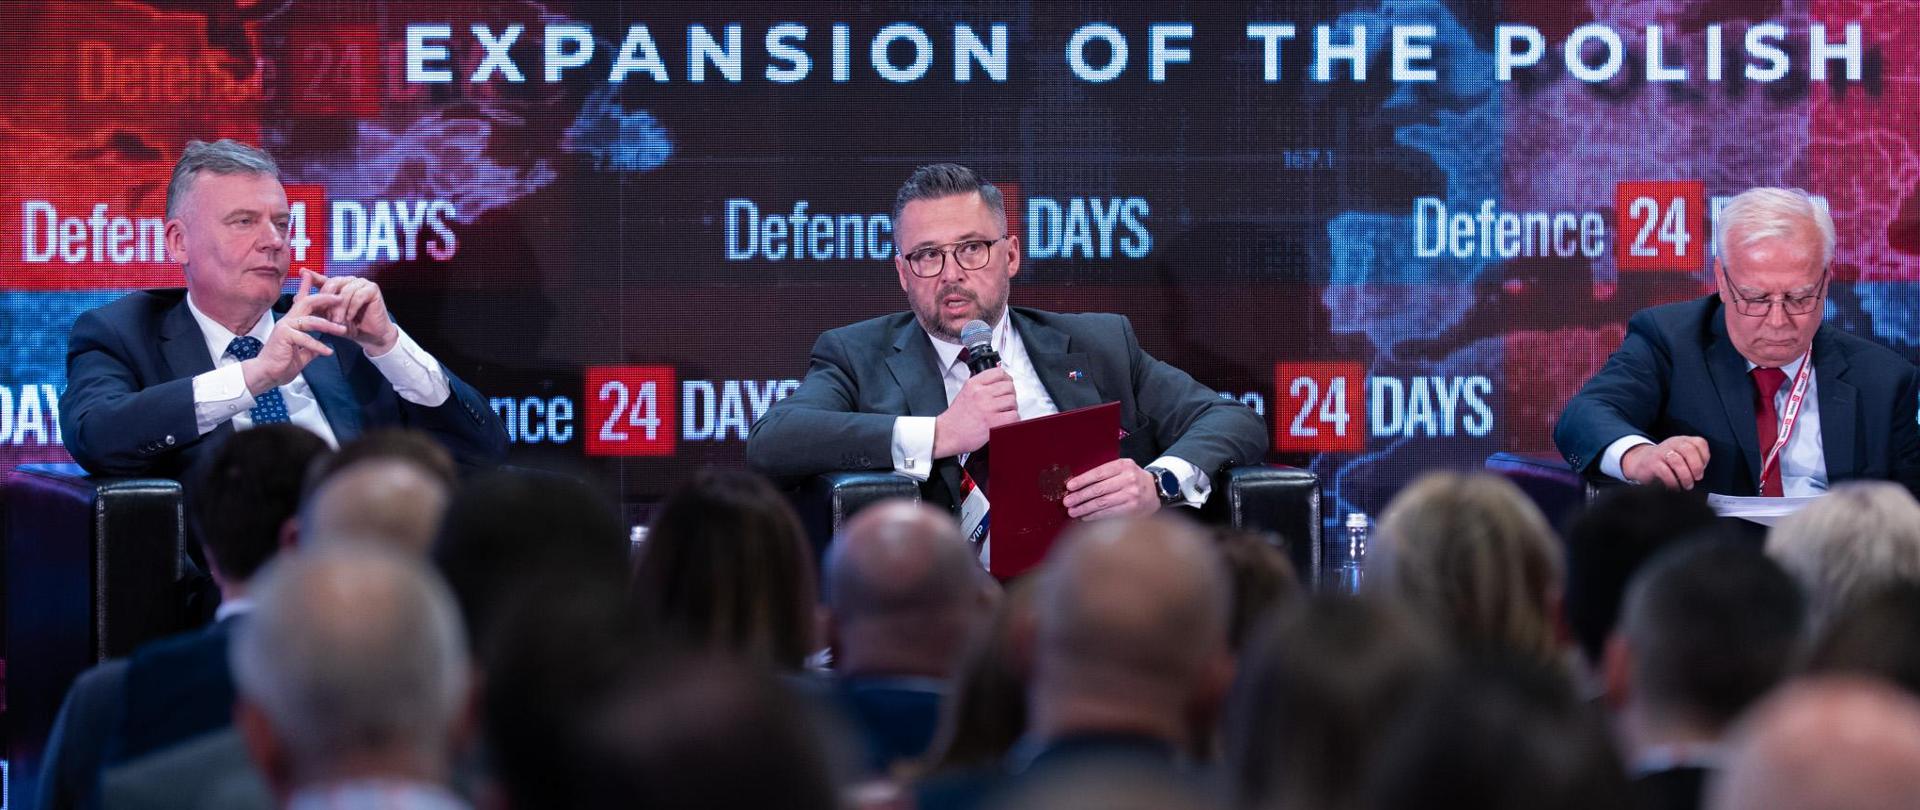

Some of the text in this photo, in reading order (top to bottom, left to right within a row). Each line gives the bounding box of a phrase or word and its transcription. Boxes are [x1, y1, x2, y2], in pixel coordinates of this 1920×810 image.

[405, 23, 1008, 82] EXPANSION
[1066, 22, 1193, 82] OF
[1246, 23, 1437, 82] THE
[1494, 22, 1863, 82] POLISH
[22, 200, 168, 262] Defen
[332, 200, 458, 262] DAYS
[724, 197, 1153, 261] Defenc DAYS
[1413, 197, 1605, 258] Defence
[1630, 196, 1690, 257] 24
[599, 380, 661, 441] 24
[682, 379, 800, 441] DAY
[1289, 376, 1350, 437] 24
[1371, 376, 1494, 438] DAYS
[969, 524, 984, 543] VIP
